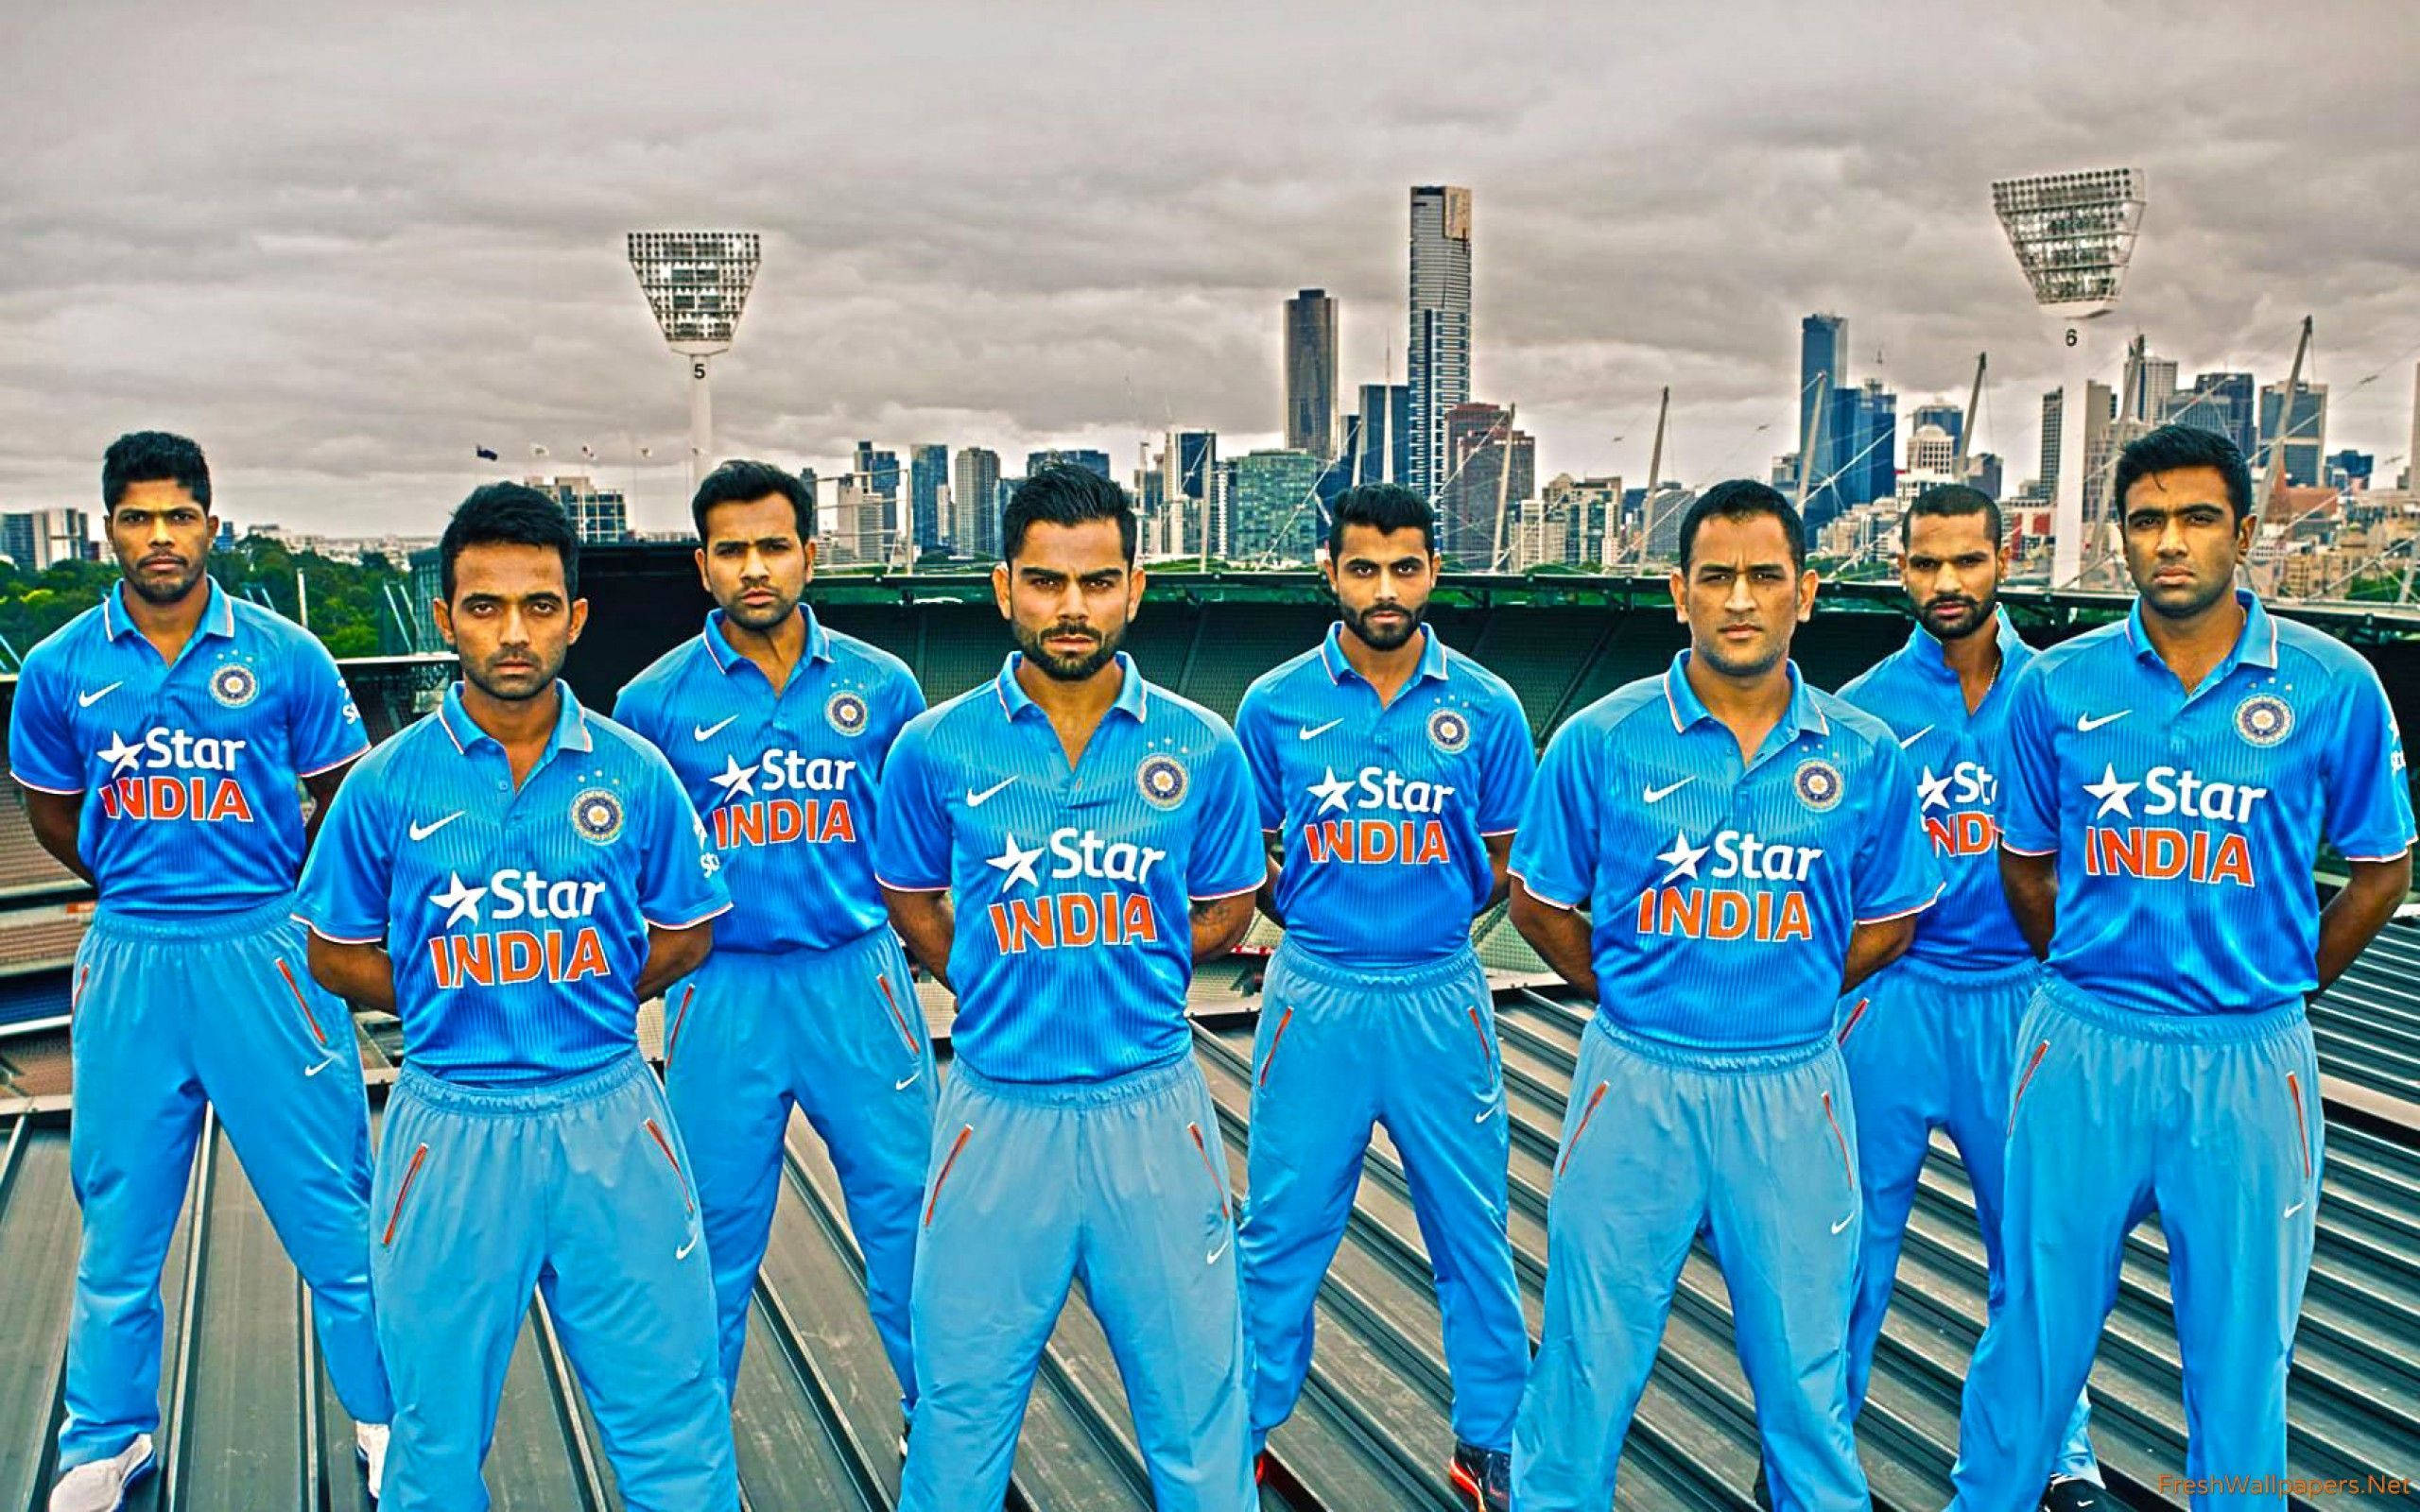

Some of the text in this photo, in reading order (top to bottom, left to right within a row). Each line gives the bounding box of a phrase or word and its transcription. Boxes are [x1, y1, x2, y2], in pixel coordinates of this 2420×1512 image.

[2066, 329, 2077, 347] 6
[694, 363, 706, 379] 5
[146, 727, 245, 771] Star
[762, 748, 856, 792] Star
[99, 776, 253, 822] INDIA
[1358, 766, 1454, 814] Star
[1954, 762, 1997, 805] St
[2144, 766, 2266, 824] Star
[713, 799, 856, 850] INDIA
[1305, 819, 1450, 864] INDIA
[1920, 811, 1998, 858] ND
[1049, 828, 1166, 884] Star
[1712, 831, 1822, 883] Star
[2086, 826, 2255, 888] INDIA
[492, 869, 606, 920] Star
[1637, 886, 1812, 942] INDIA
[989, 892, 1156, 955] INDIA
[428, 927, 611, 988] INDIA
